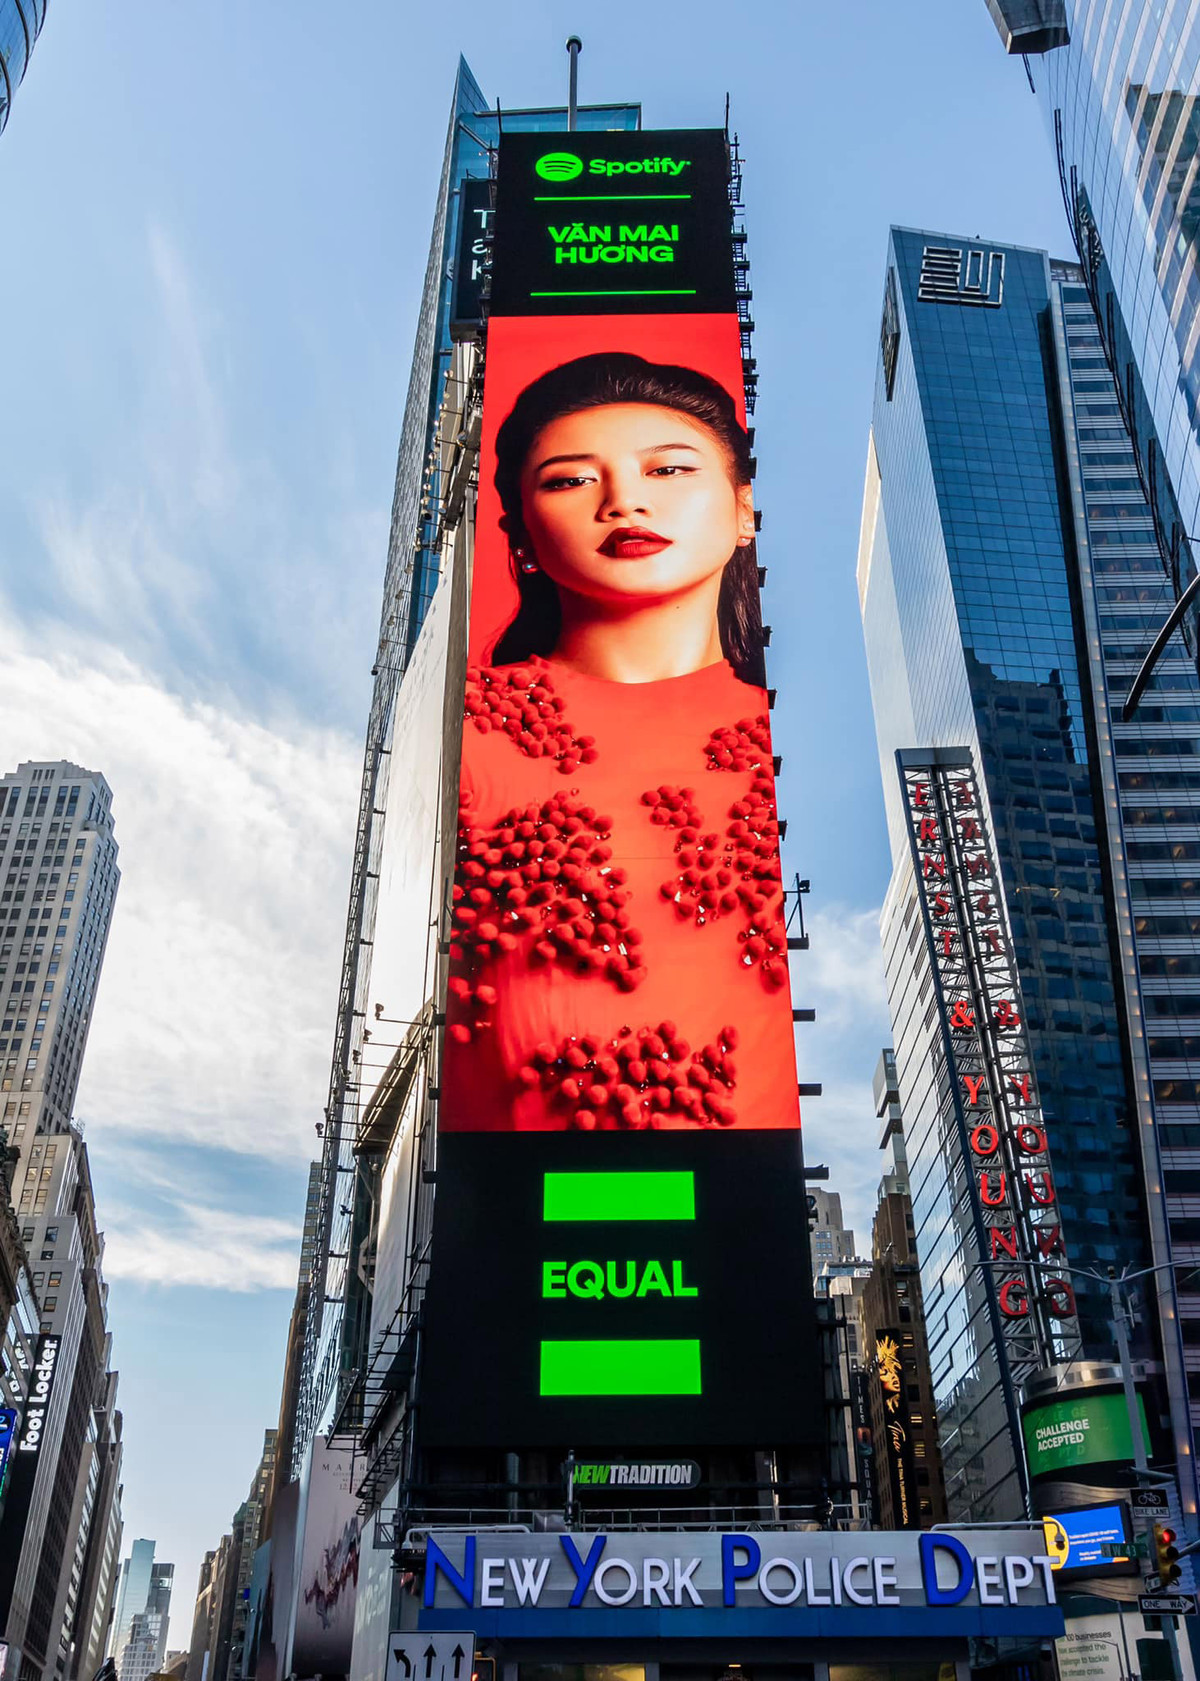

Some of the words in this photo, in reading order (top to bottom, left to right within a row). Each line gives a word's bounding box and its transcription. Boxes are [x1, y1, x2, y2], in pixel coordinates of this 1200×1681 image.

[589, 157, 690, 176] Spotify
[548, 223, 611, 242] VĂN
[620, 224, 679, 242] MAI
[555, 244, 674, 264] HƯƠNG
[914, 783, 957, 956] ERNST
[963, 1075, 1028, 1316] YOUNG
[542, 1260, 698, 1300] EQUAL
[20, 1409, 44, 1451] Foot
[1036, 1419, 1090, 1439] CHALLENGE
[1038, 1432, 1084, 1452] ACCEPTED
[424, 1535, 550, 1608] NEW
[559, 1535, 704, 1608] YORK
[722, 1534, 900, 1607] POLICE
[919, 1533, 1060, 1607] DEPT
[1143, 1600, 1160, 1609] ONE
[1170, 1600, 1188, 1609] WAY
